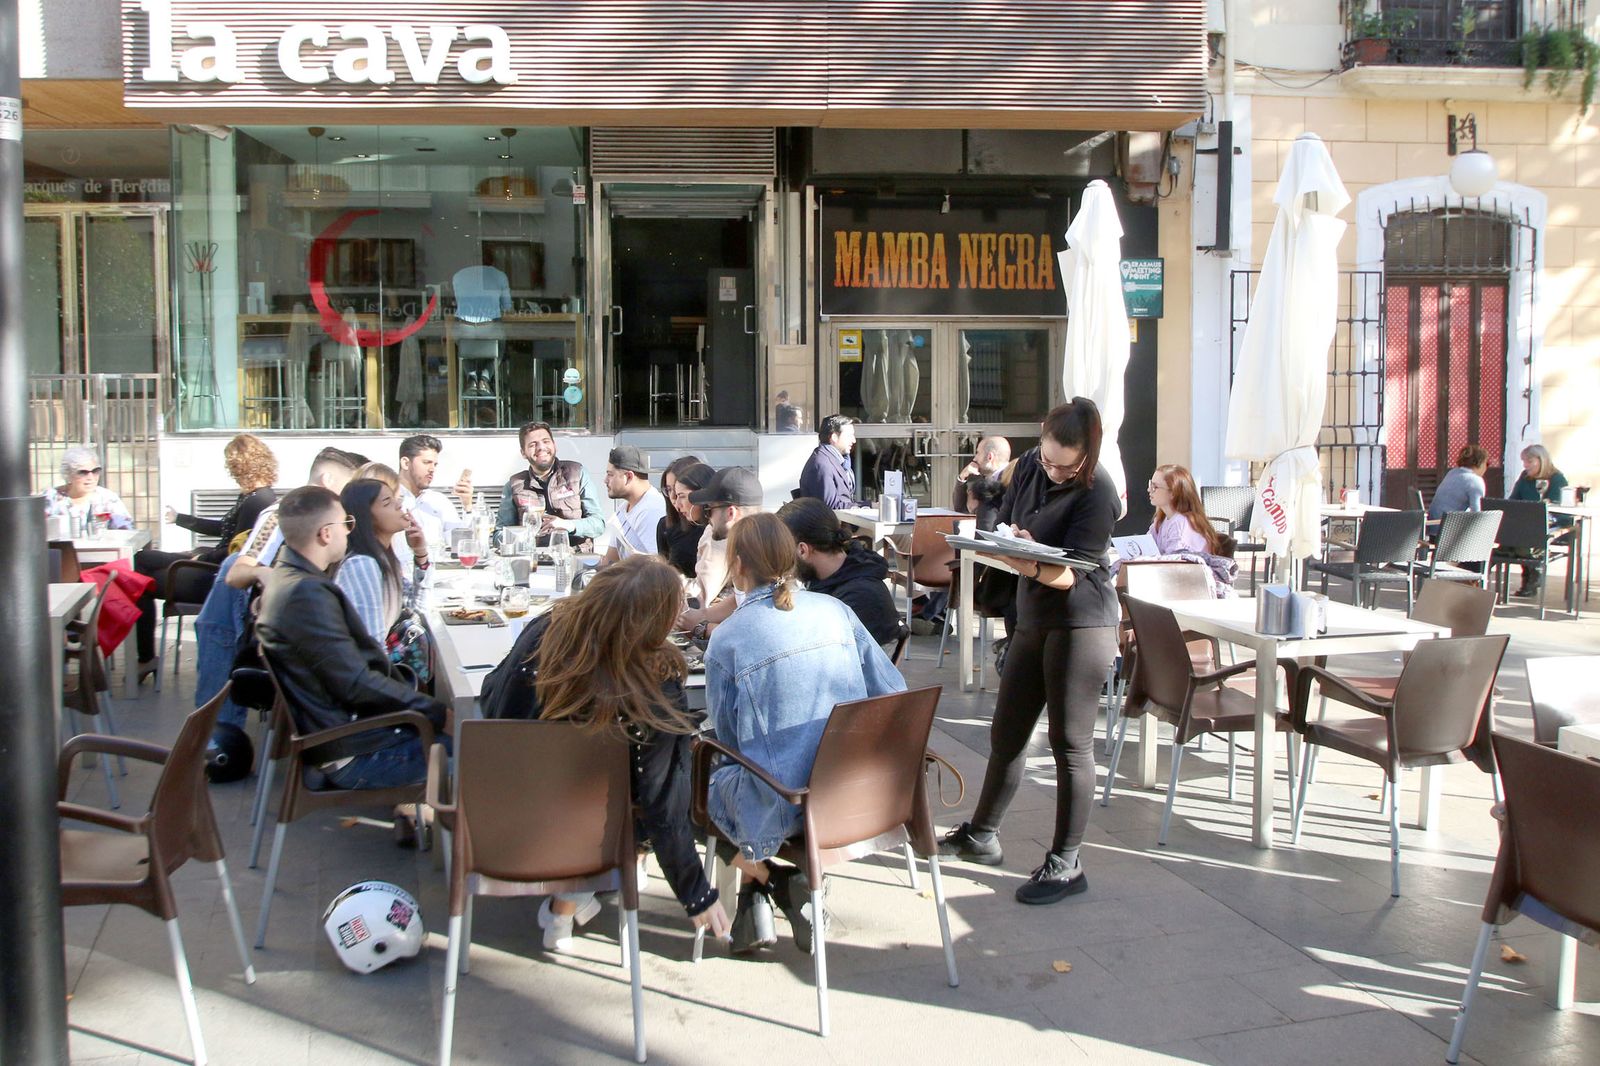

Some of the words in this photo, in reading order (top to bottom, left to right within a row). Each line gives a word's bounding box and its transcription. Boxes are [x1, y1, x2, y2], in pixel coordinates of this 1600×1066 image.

[142, 0, 245, 83] la
[277, 23, 518, 84] cava
[24, 180, 76, 195] arques
[85, 178, 102, 193] de
[111, 178, 170, 193] Heredia
[834, 231, 949, 289] MAMBA
[958, 232, 1056, 290] NEGRA
[350, 917, 369, 940] ROCK
